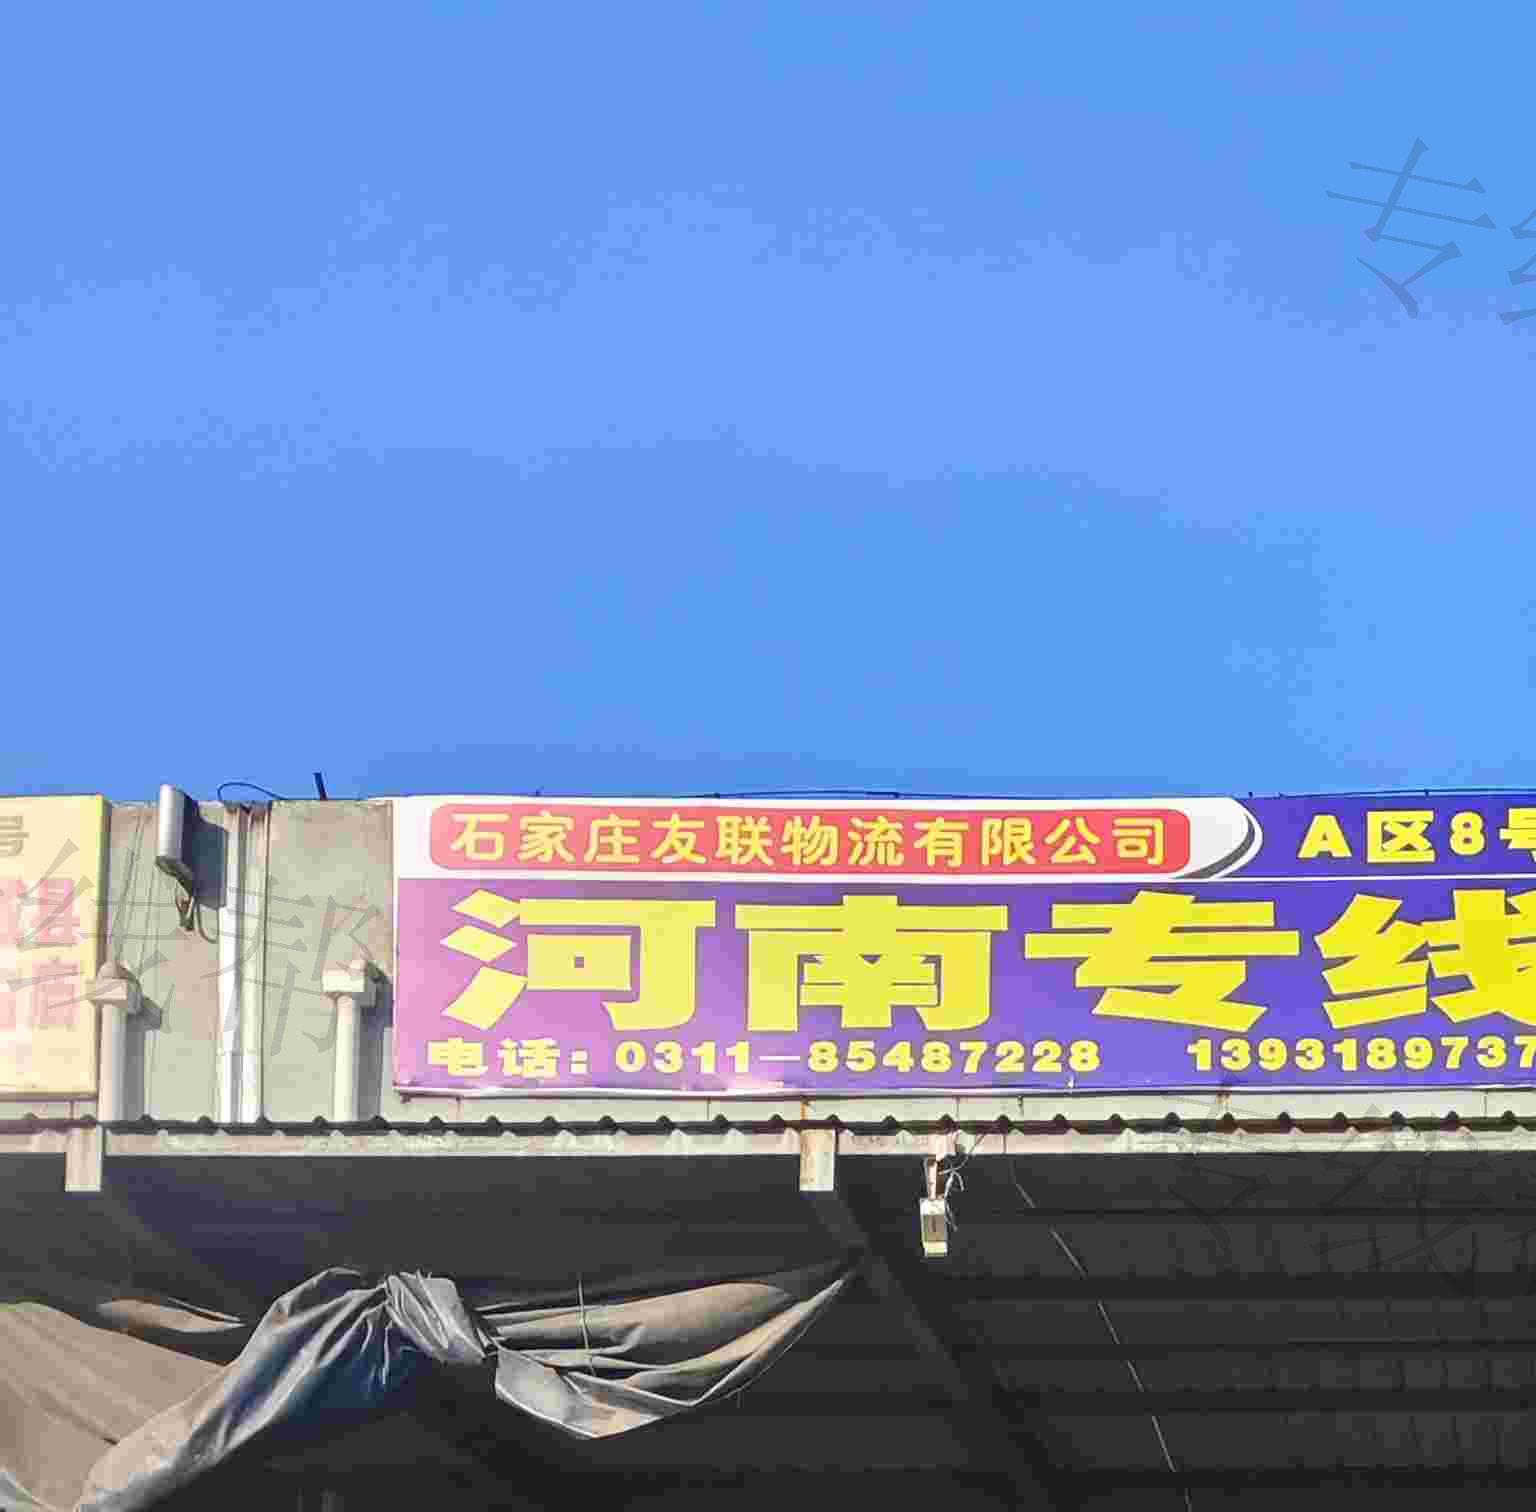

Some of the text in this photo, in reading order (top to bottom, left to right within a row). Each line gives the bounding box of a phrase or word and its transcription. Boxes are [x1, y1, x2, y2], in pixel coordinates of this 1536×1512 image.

[453, 811, 1167, 868] 石家庄友联物流有限公司
